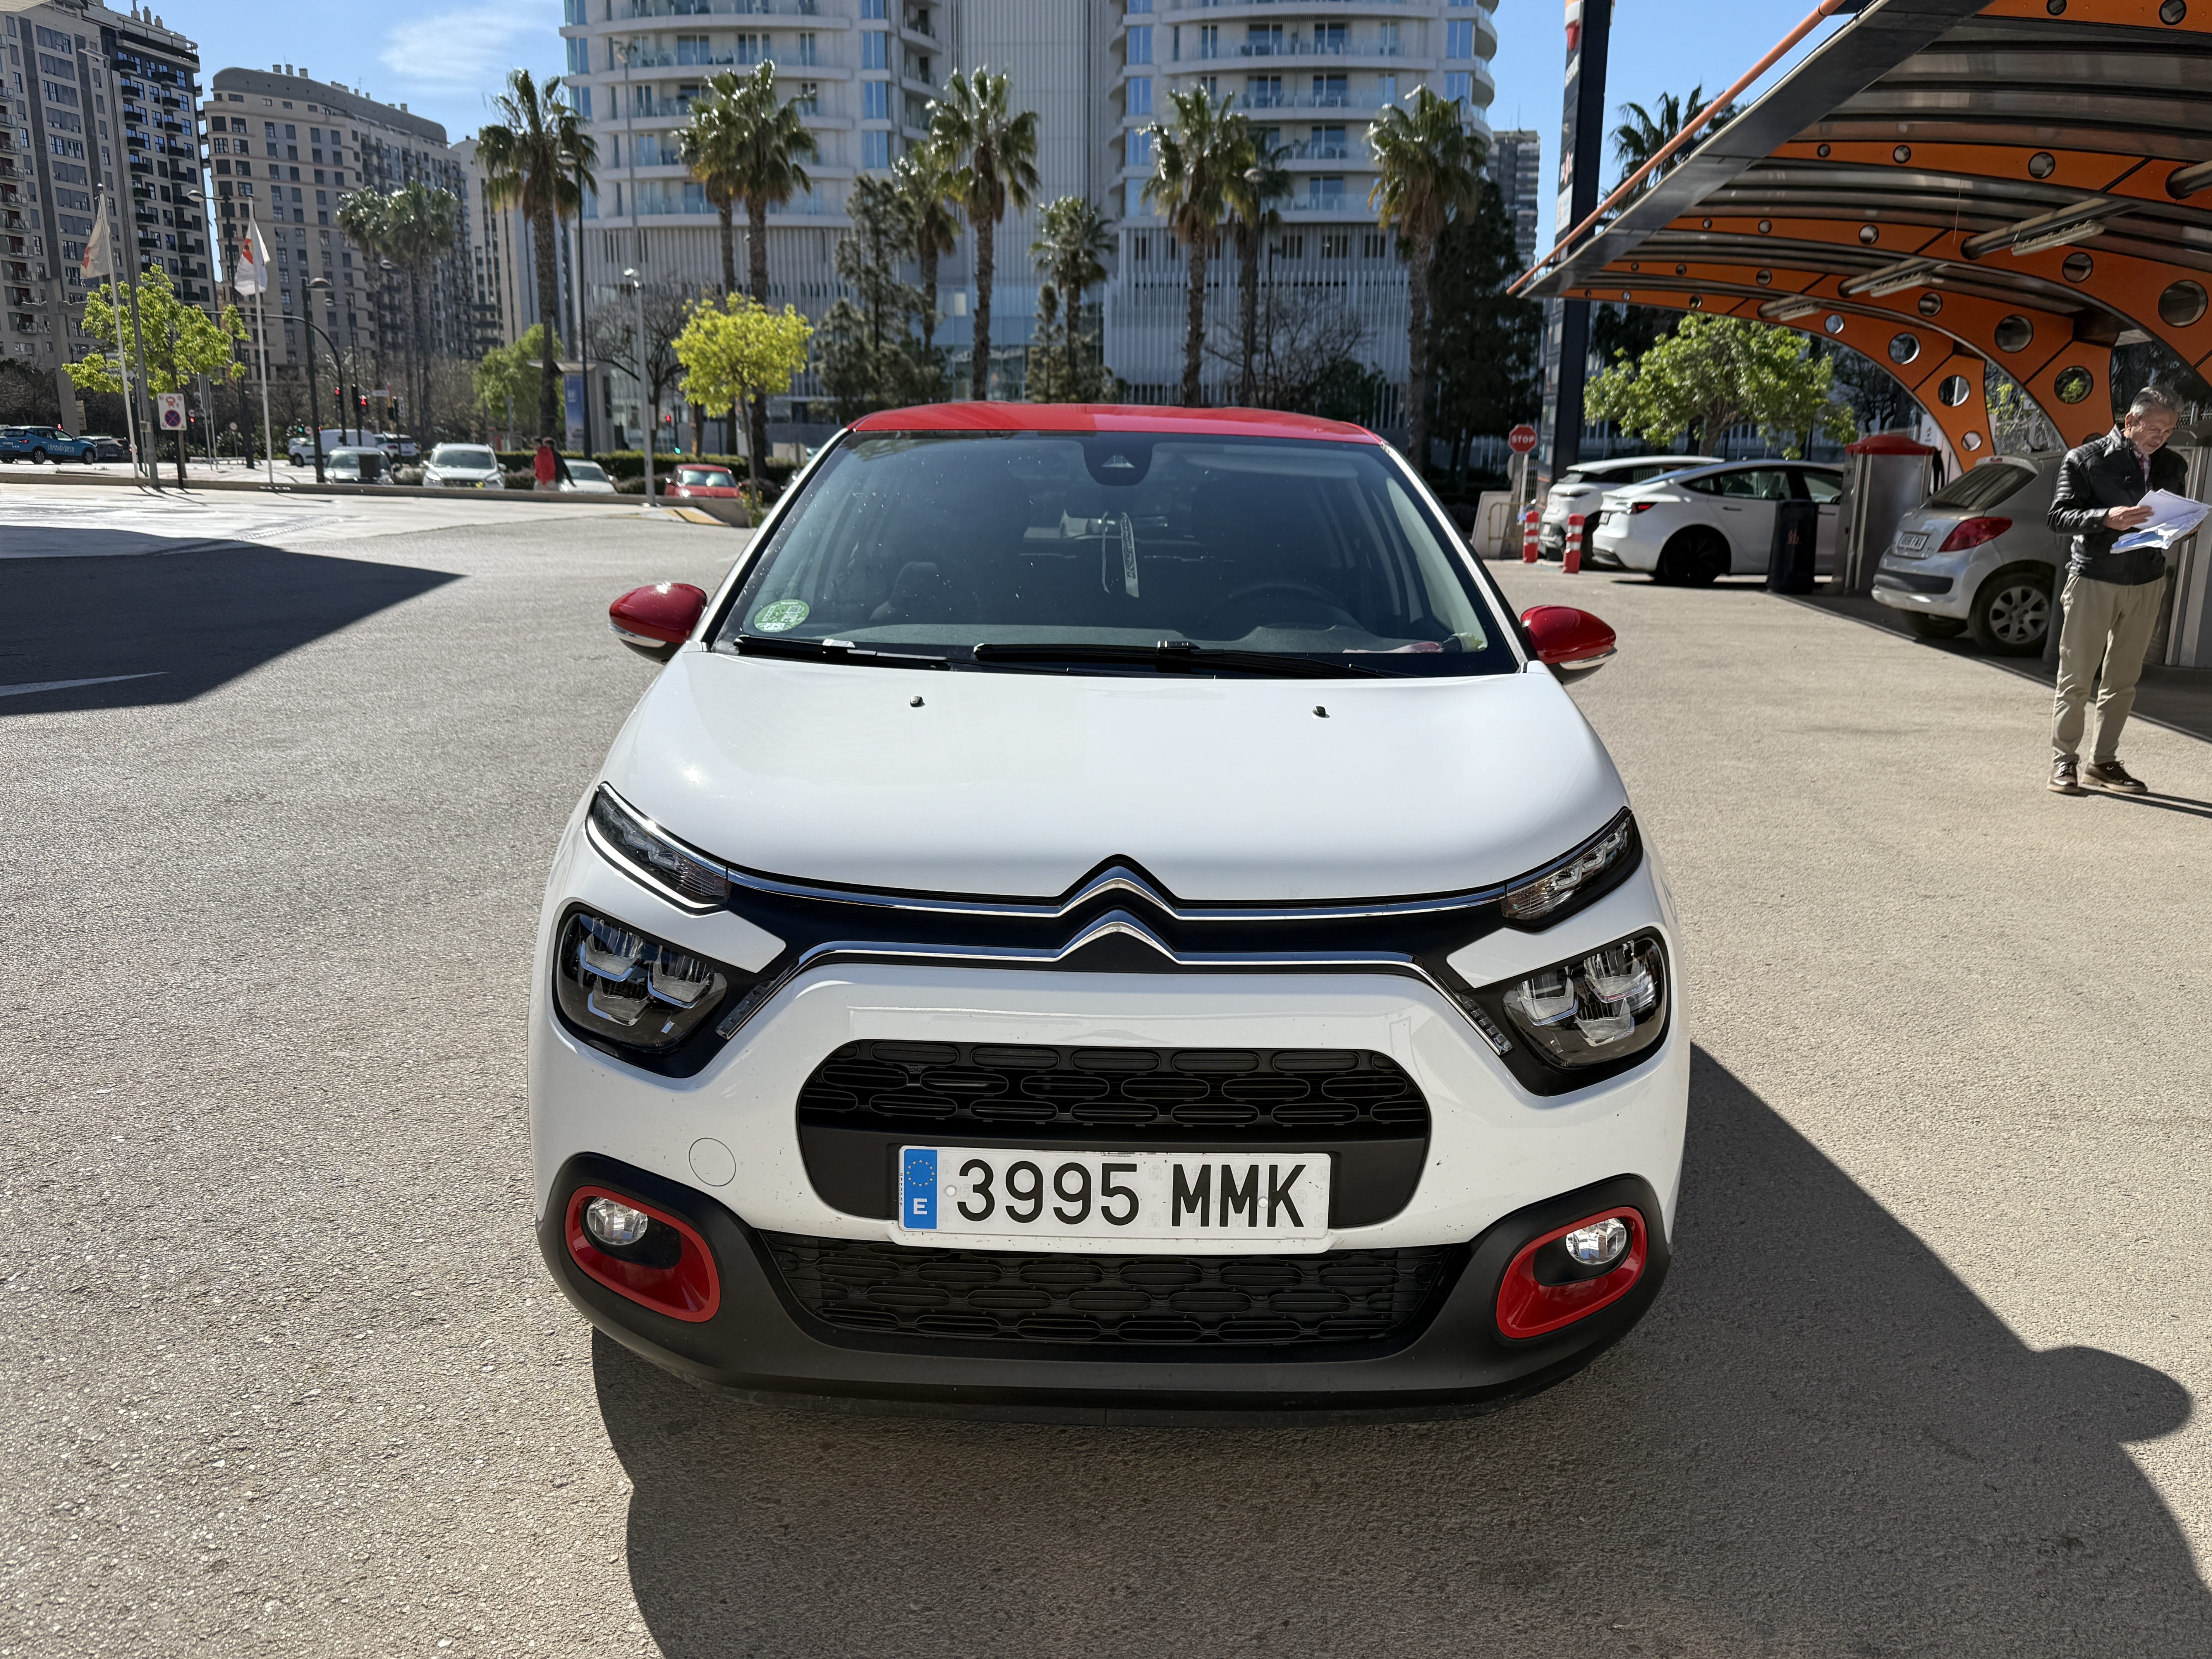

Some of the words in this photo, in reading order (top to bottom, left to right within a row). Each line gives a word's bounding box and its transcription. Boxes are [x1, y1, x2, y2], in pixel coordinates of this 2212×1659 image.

[1511, 434, 1534, 443] STOP
[957, 1159, 1139, 1226] 3995
[1172, 1164, 1306, 1227] MMK
[913, 1198, 927, 1215] E
